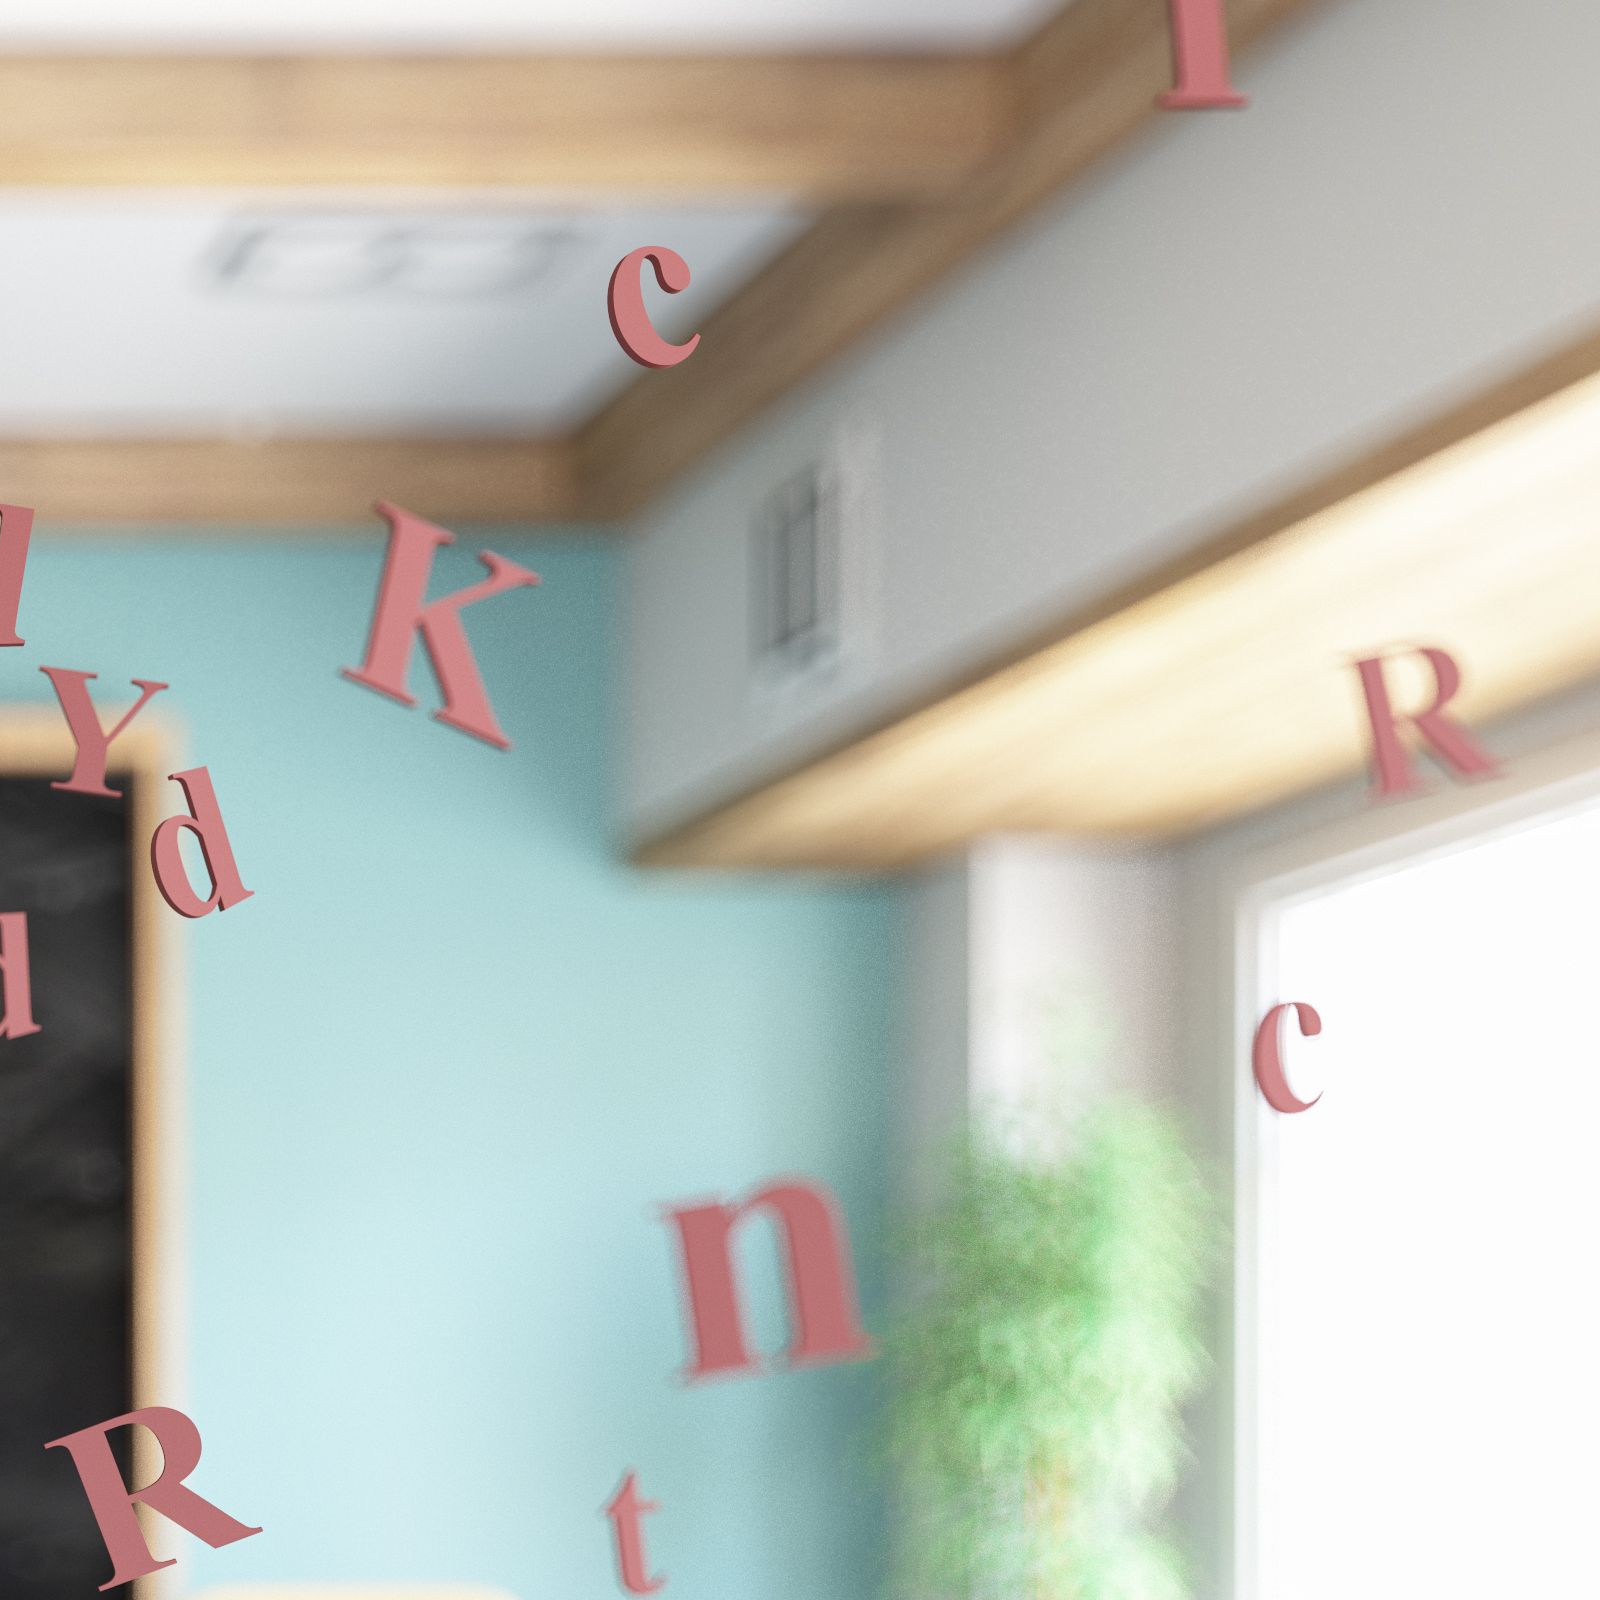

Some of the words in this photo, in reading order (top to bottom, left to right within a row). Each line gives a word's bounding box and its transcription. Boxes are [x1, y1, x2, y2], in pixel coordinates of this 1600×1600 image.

[606, 245, 701, 369] c
[341, 501, 537, 750] K
[39, 665, 169, 799] Y
[1340, 645, 1508, 803] R
[150, 766, 255, 919] d
[1251, 1002, 1325, 1115] c
[655, 1173, 882, 1388] n
[43, 1405, 262, 1592] R
[603, 1466, 668, 1598] t
